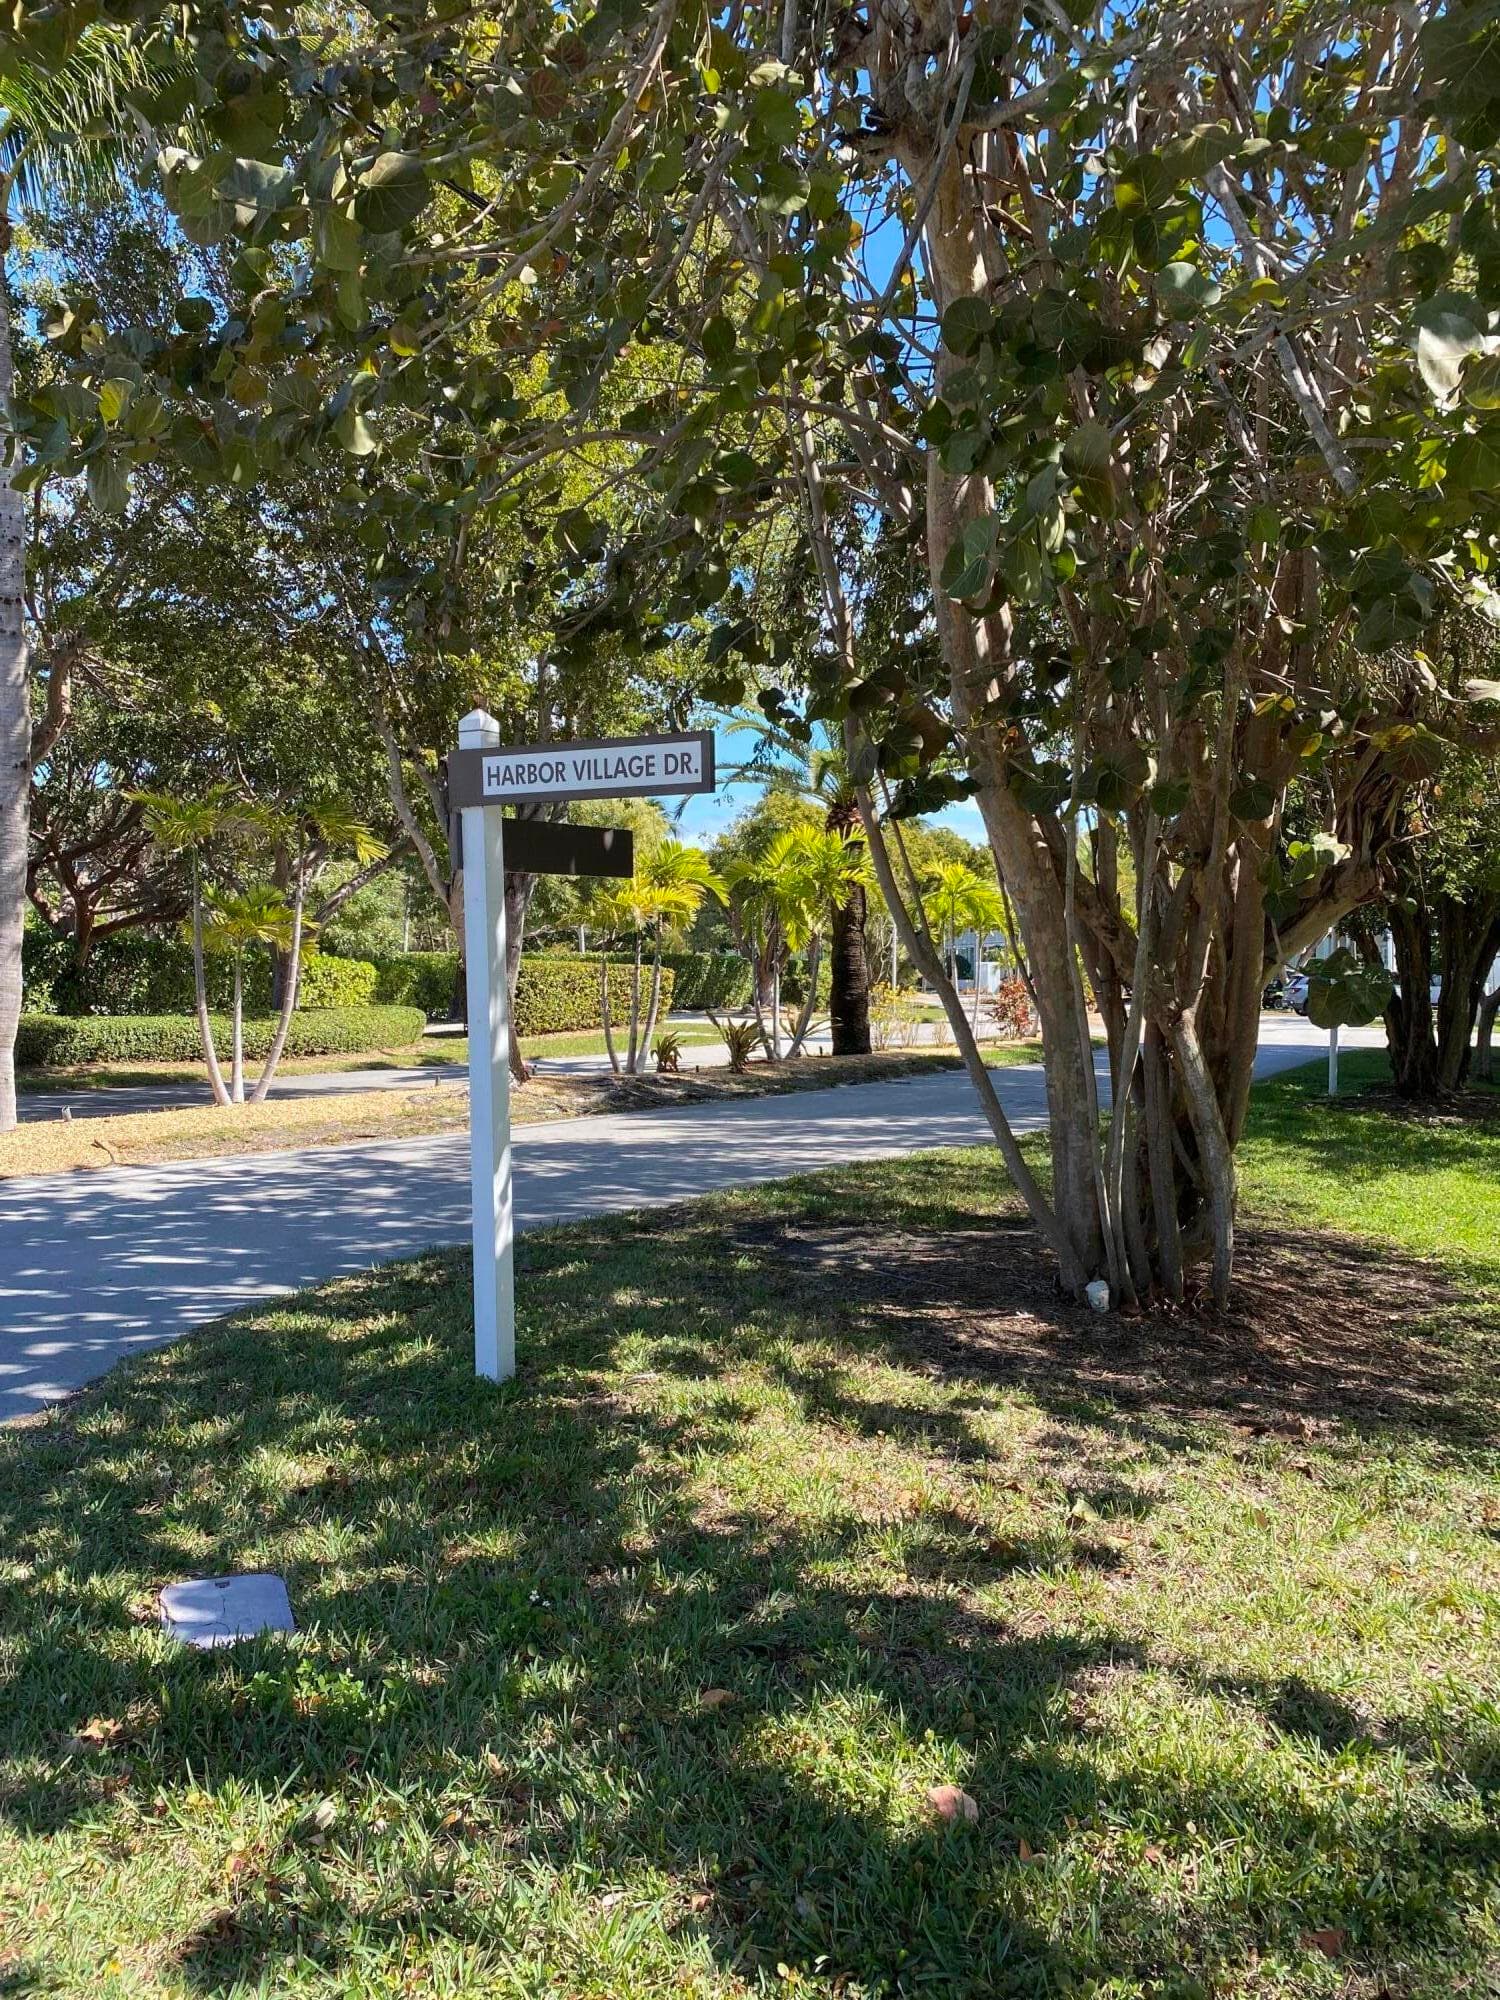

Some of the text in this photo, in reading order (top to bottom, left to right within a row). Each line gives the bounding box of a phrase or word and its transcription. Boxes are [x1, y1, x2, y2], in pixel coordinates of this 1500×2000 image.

[487, 752, 699, 787] HARBOR VILLAGE DR.
